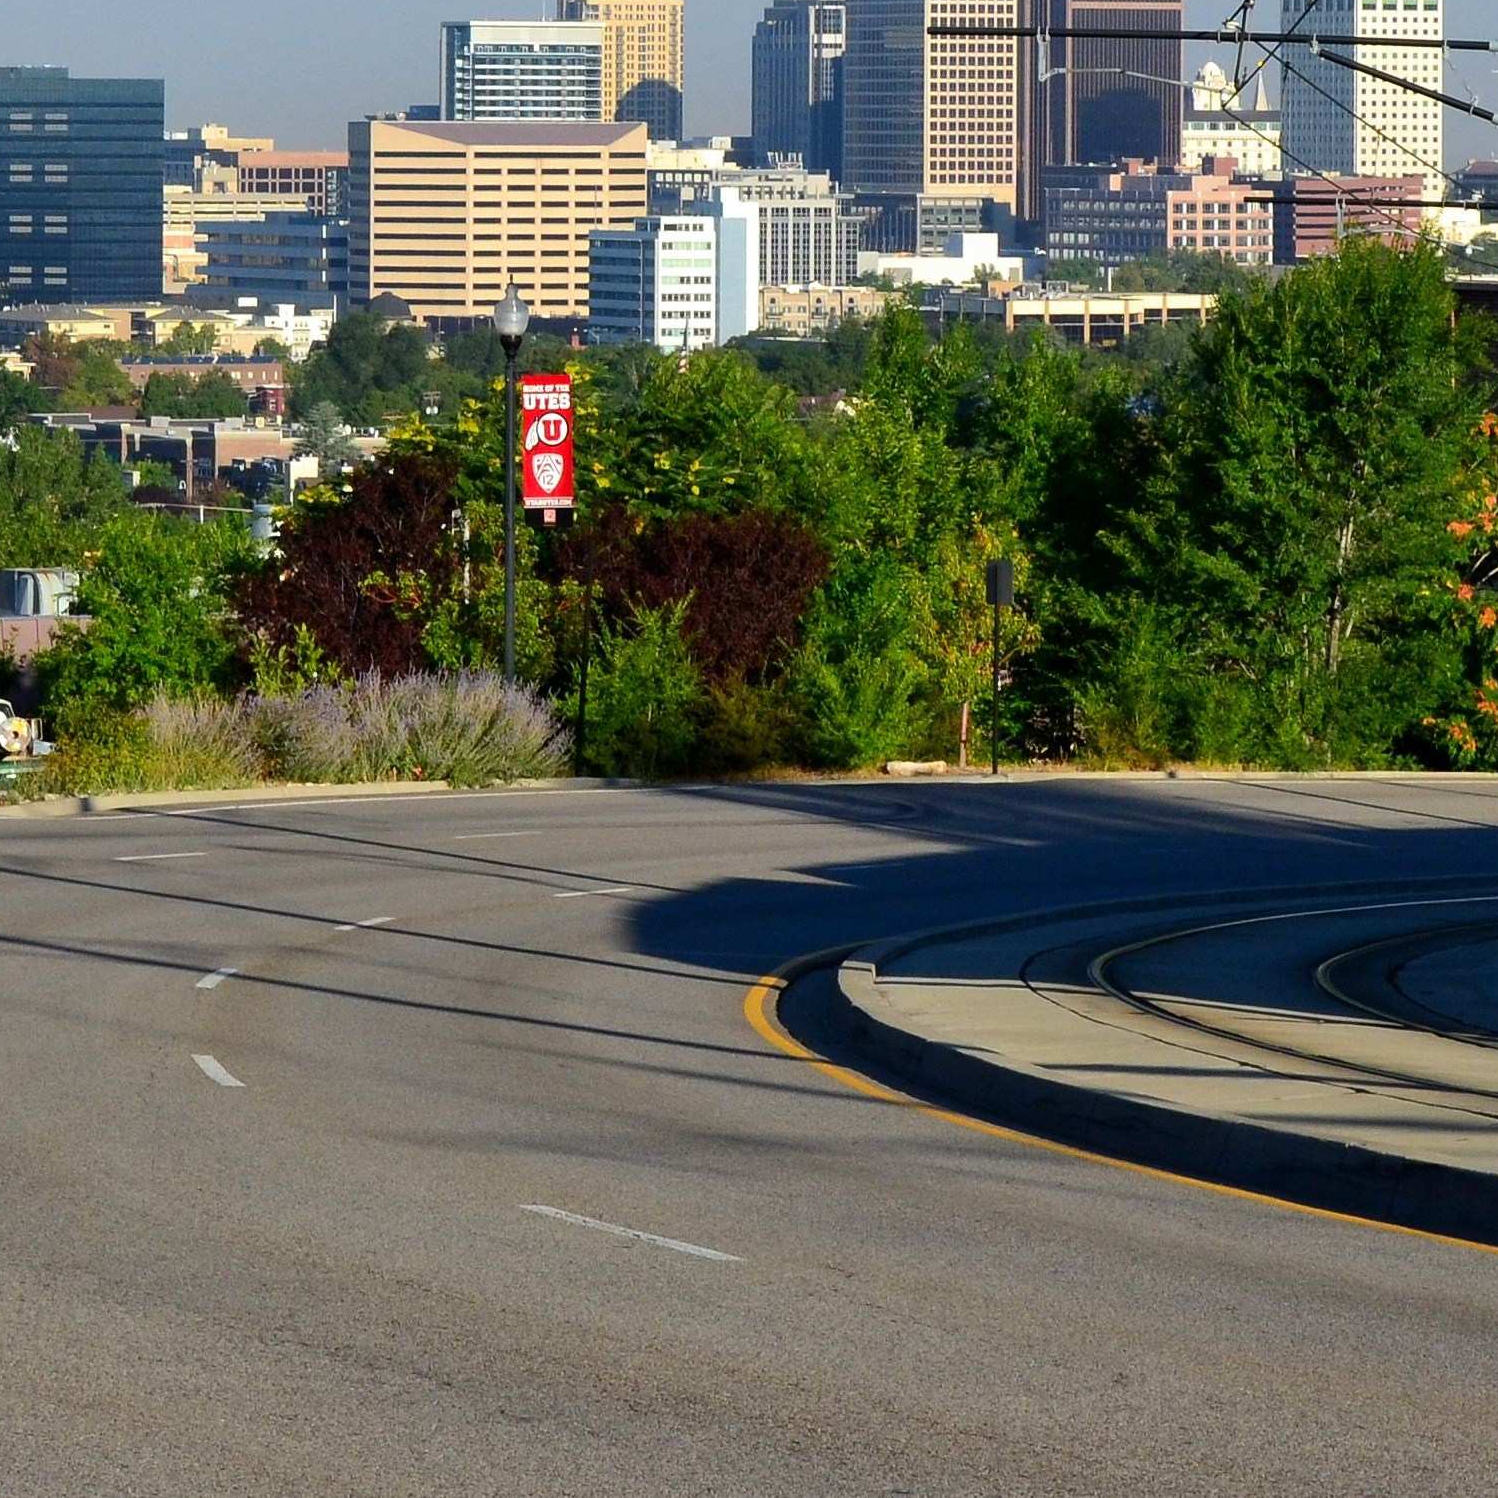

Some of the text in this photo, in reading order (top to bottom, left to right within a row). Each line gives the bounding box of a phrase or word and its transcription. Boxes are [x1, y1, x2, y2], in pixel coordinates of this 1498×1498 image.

[523, 393, 571, 410] UTES
[543, 420, 562, 440] U
[542, 474, 554, 485] 12
